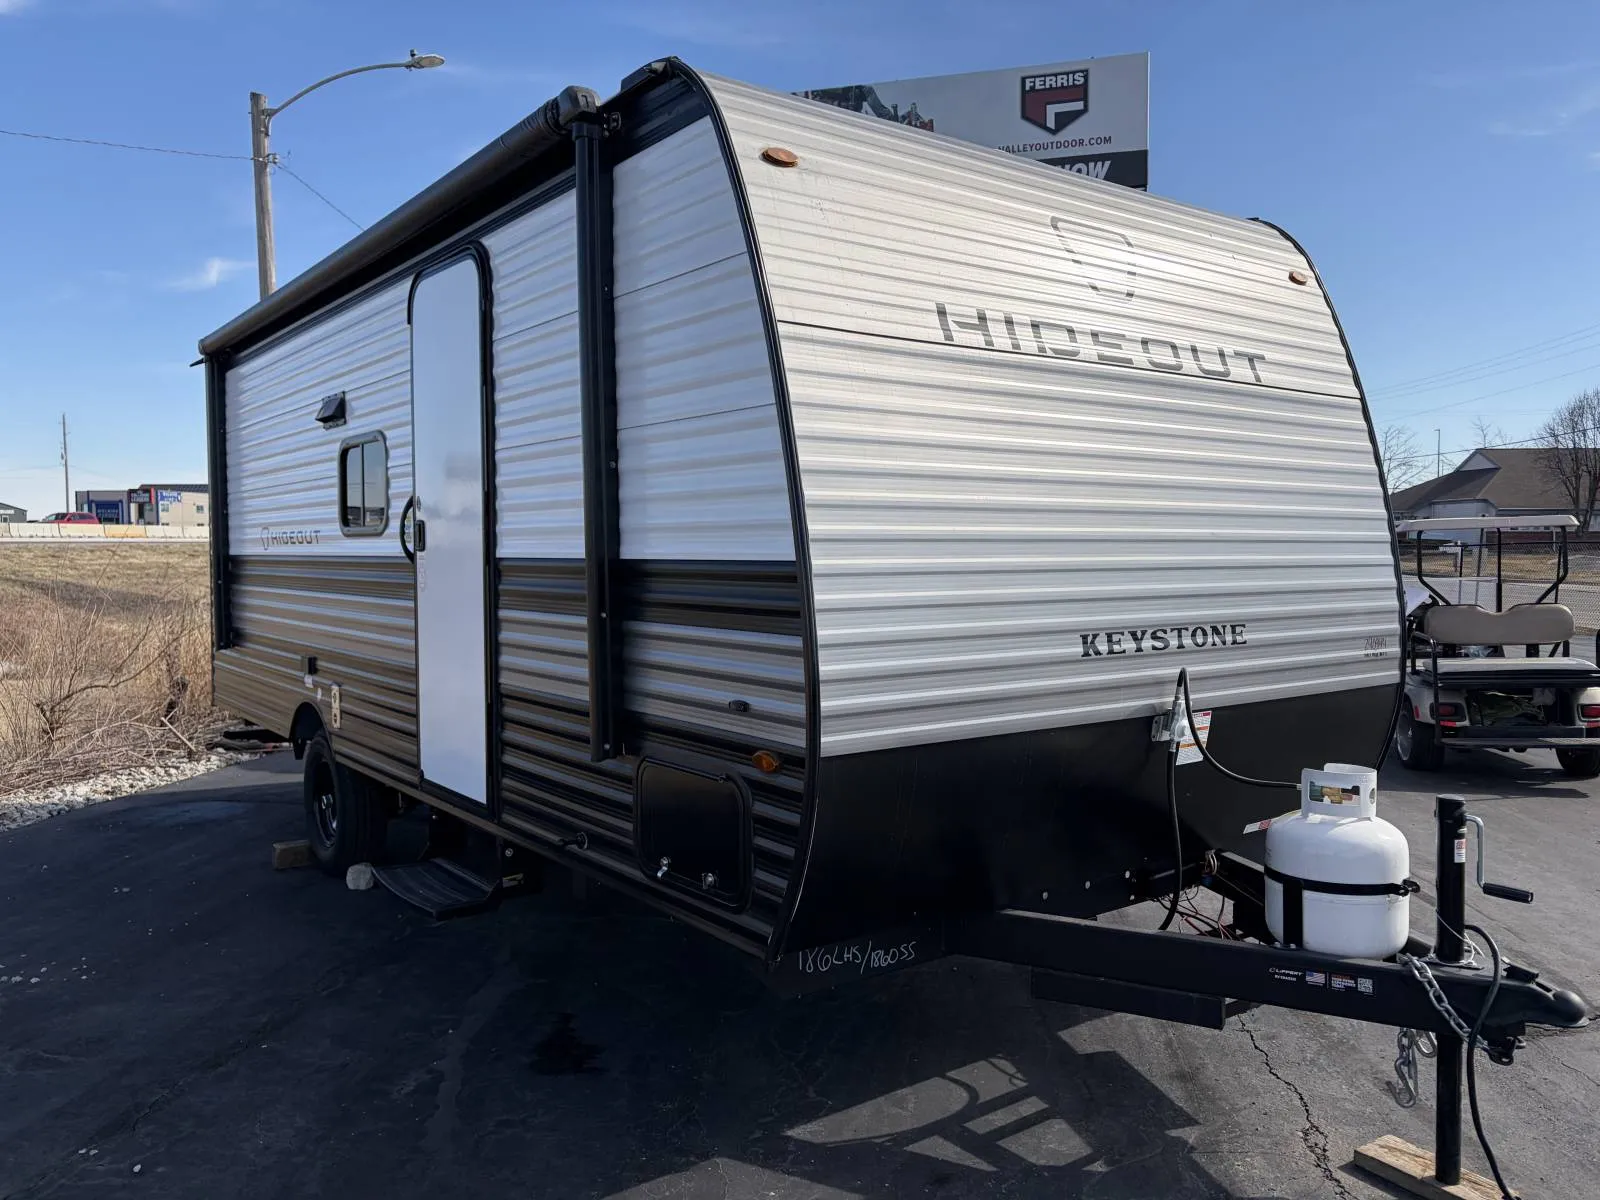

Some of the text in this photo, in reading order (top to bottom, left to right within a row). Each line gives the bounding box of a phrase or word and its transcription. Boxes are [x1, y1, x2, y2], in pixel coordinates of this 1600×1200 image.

[1025, 72, 1085, 91] FERRIS
[935, 302, 1266, 384] HIDEOUT
[271, 530, 321, 545] HIDEOUT
[1079, 623, 1248, 658] KEYSTONE
